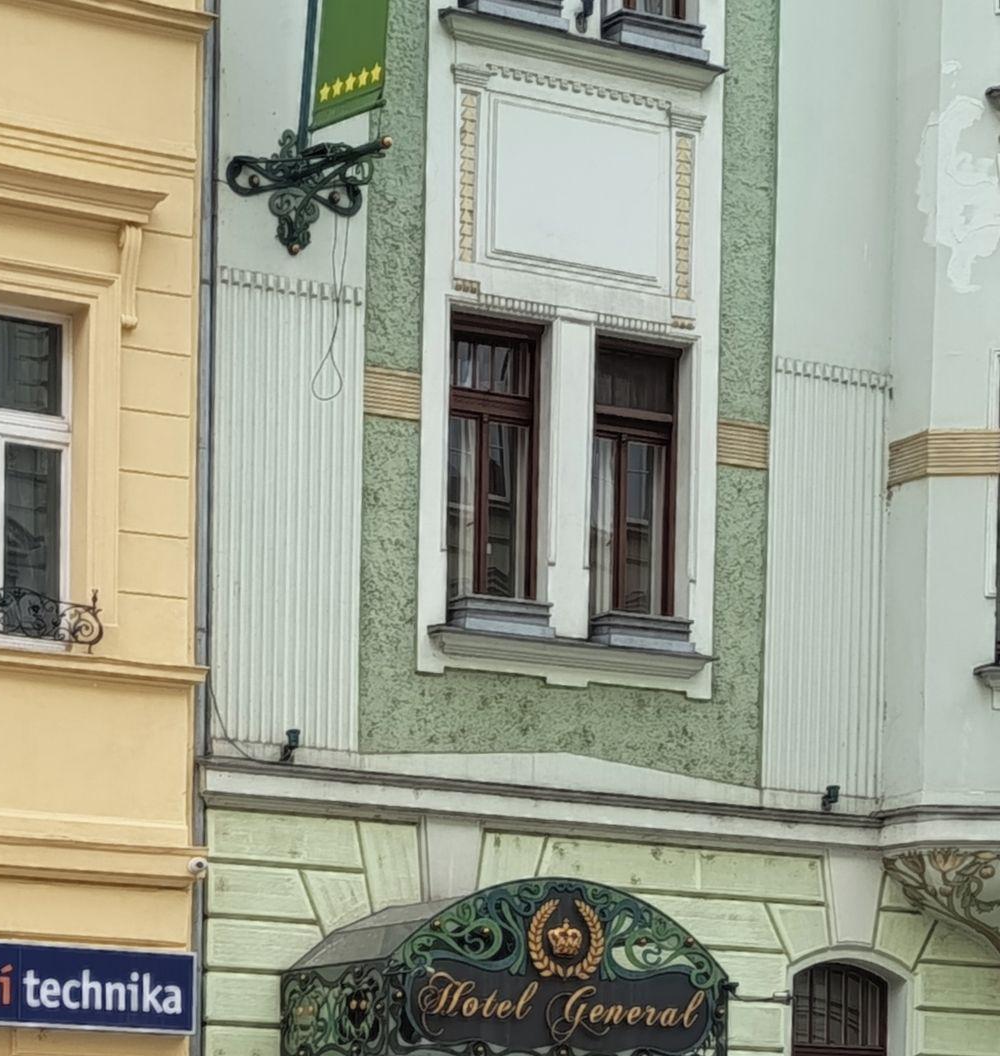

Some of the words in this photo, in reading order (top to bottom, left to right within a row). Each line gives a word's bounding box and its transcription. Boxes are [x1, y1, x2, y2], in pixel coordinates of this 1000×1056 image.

[22, 968, 183, 1016] technika
[417, 971, 540, 1036] Hotel
[546, 985, 706, 1042] General
